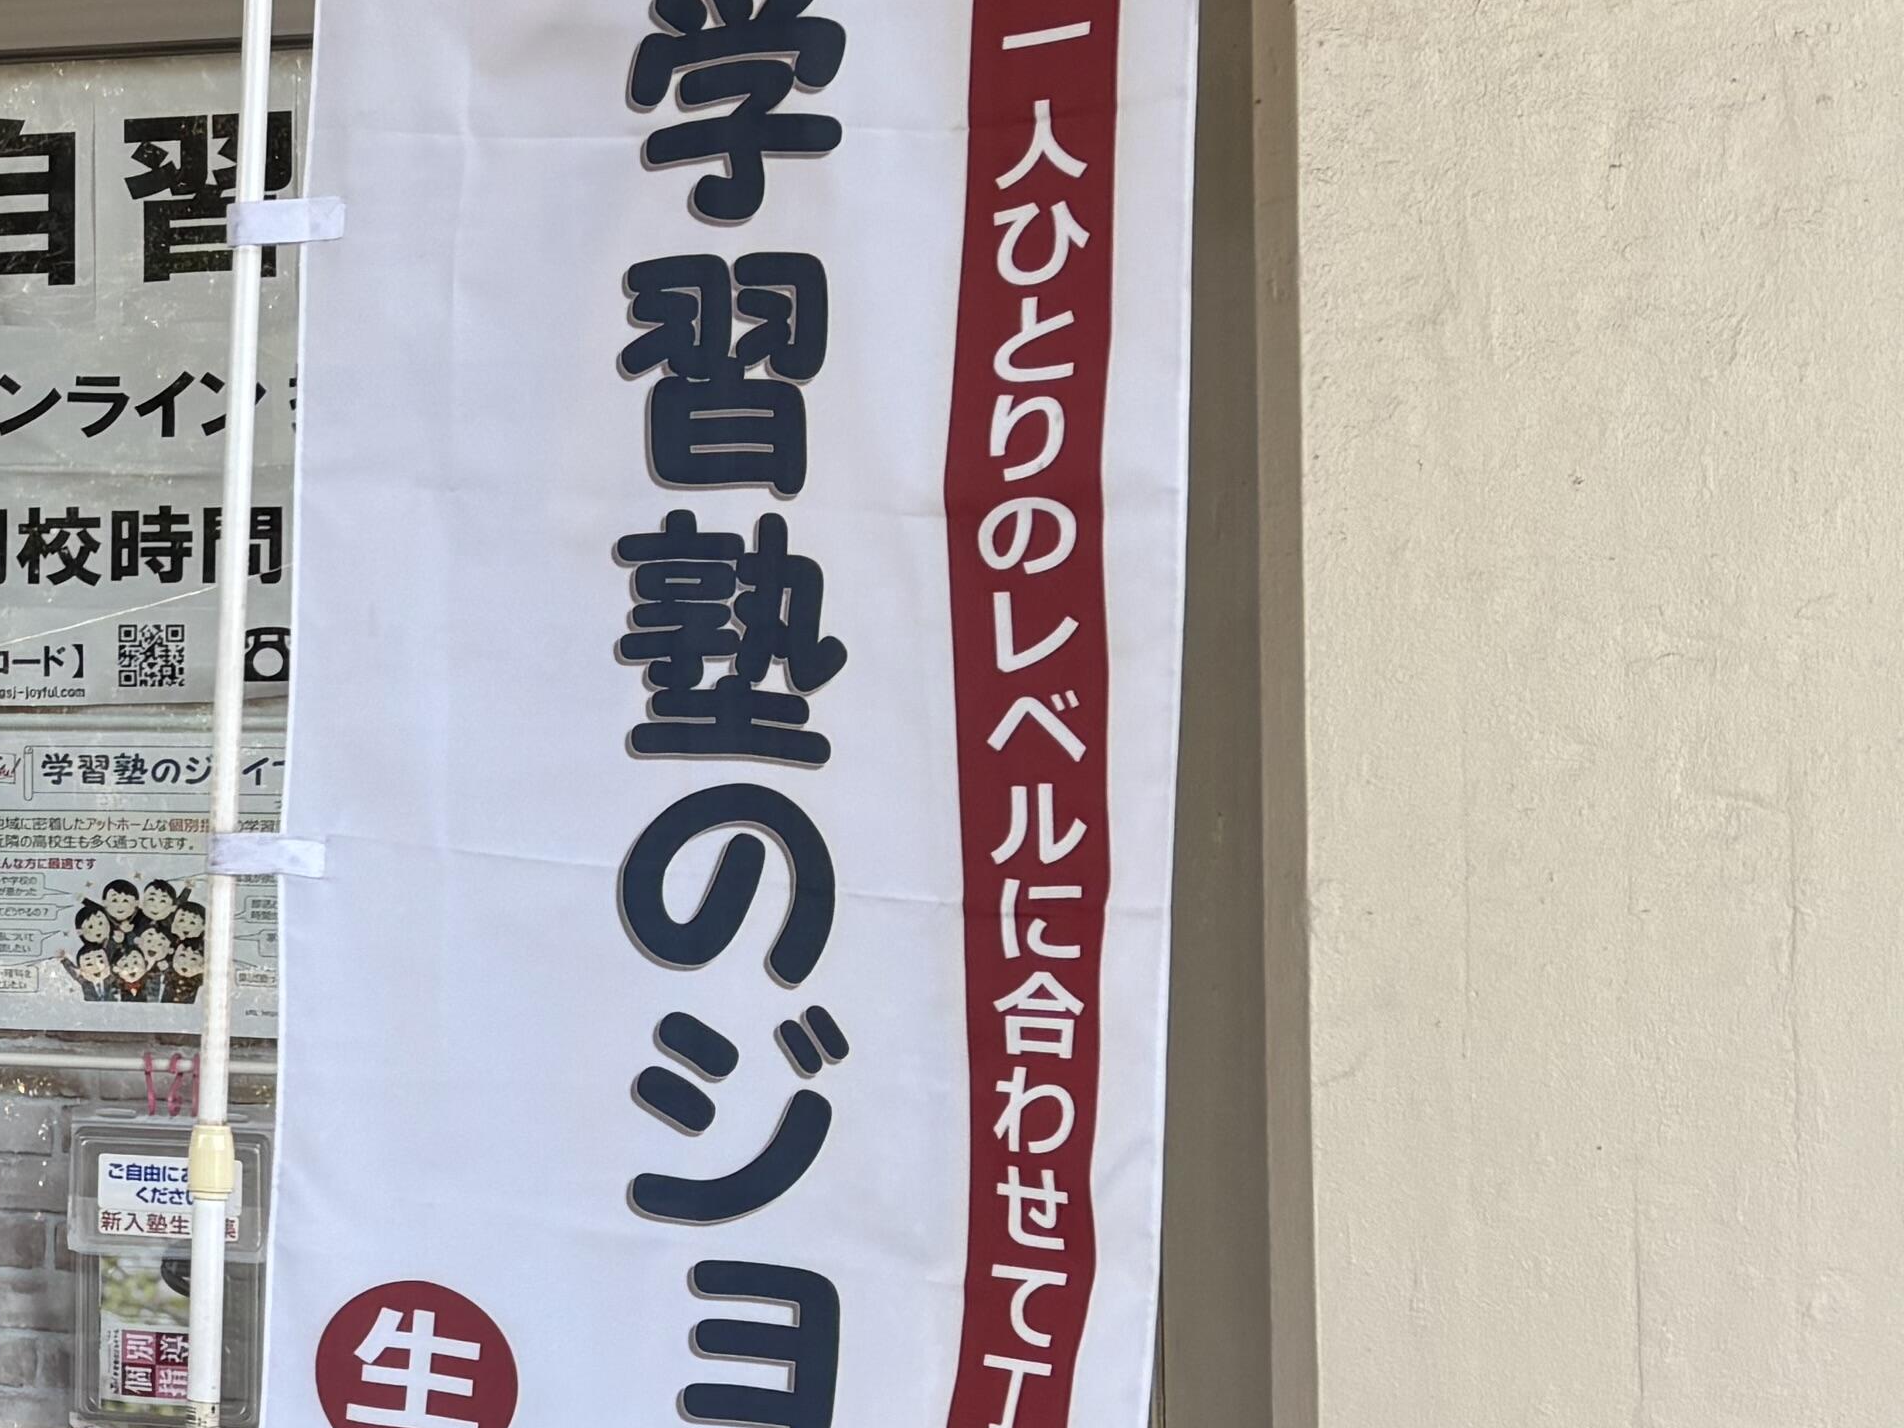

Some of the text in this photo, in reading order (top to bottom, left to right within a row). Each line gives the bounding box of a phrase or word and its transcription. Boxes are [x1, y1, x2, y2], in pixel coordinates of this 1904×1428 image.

[42, 753, 285, 785] 学習塾のジイ
[101, 1210, 236, 1238] 新入塾生集
